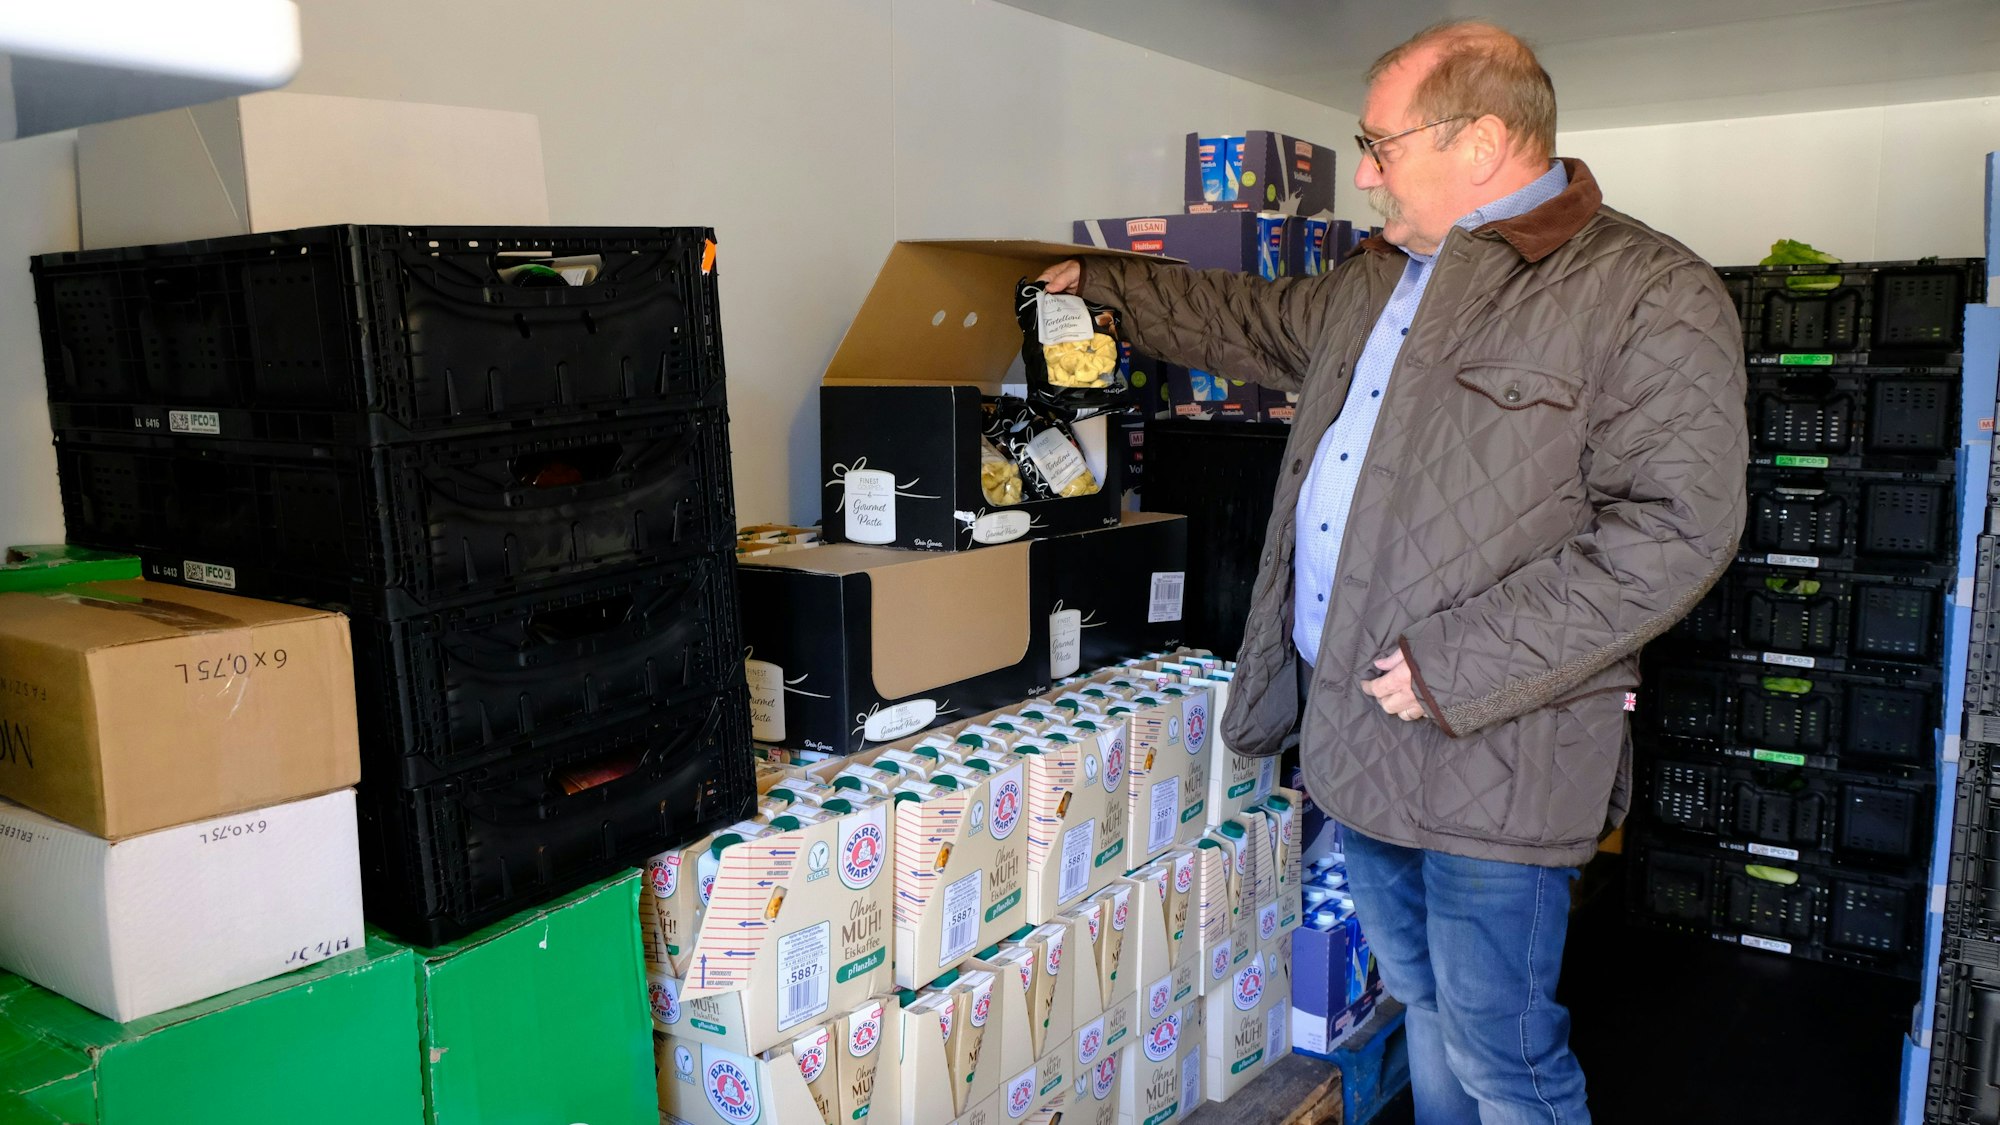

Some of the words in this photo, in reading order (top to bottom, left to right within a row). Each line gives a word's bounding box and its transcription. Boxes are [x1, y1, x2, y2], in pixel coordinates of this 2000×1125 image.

[1131, 223, 1162, 232] MILSANI
[1045, 315, 1081, 326] Tortelloni
[135, 418, 142, 428] LL
[146, 418, 159, 428] 6416
[191, 414, 208, 426] IFCO
[853, 499, 886, 514] Gourmet
[857, 514, 882, 527] Pasta
[152, 565, 160, 574] LL
[163, 566, 177, 577] 6413
[205, 566, 223, 578] IFCO
[1052, 638, 1074, 654] Gourmet
[197, 654, 247, 681] 0,75
[274, 649, 287, 668] 6
[175, 664, 188, 684] L
[881, 723, 904, 738] Gourmet
[904, 718, 921, 728] Pasta
[1100, 808, 1122, 838] MUH!
[1157, 807, 1172, 820] 5887
[212, 825, 242, 841] 0,75
[258, 820, 267, 833] 6
[847, 827, 880, 853] BÄREN
[846, 853, 880, 878] MARKE
[995, 846, 1015, 868] Ohne
[1068, 852, 1085, 868] 5887
[808, 870, 828, 881] VEGAN
[990, 856, 1019, 891] MUH!
[991, 879, 1017, 902] Eiskaffee
[850, 896, 877, 920] Ohne
[993, 896, 1015, 918] pflanzlich
[952, 908, 972, 926] 5887
[842, 909, 882, 947] MUH!
[845, 937, 880, 960] Eiskaffee
[791, 964, 818, 983] 5887
[848, 955, 877, 979] pflanzlich
[689, 1000, 720, 1015] MUH!
[694, 1010, 719, 1022] Eiskaffee
[1240, 1015, 1259, 1032] Ohne
[1150, 1034, 1178, 1054] MARKE
[1235, 1023, 1262, 1049] MUH!
[1236, 1042, 1260, 1058] Eiskaffee
[710, 1064, 749, 1091] BÄREN
[856, 1065, 876, 1081] Ohne
[1152, 1065, 1174, 1085] Ohne
[1146, 1075, 1177, 1104] MUH!
[712, 1089, 751, 1116] MARKE
[1148, 1095, 1176, 1113] Eiskaffee
